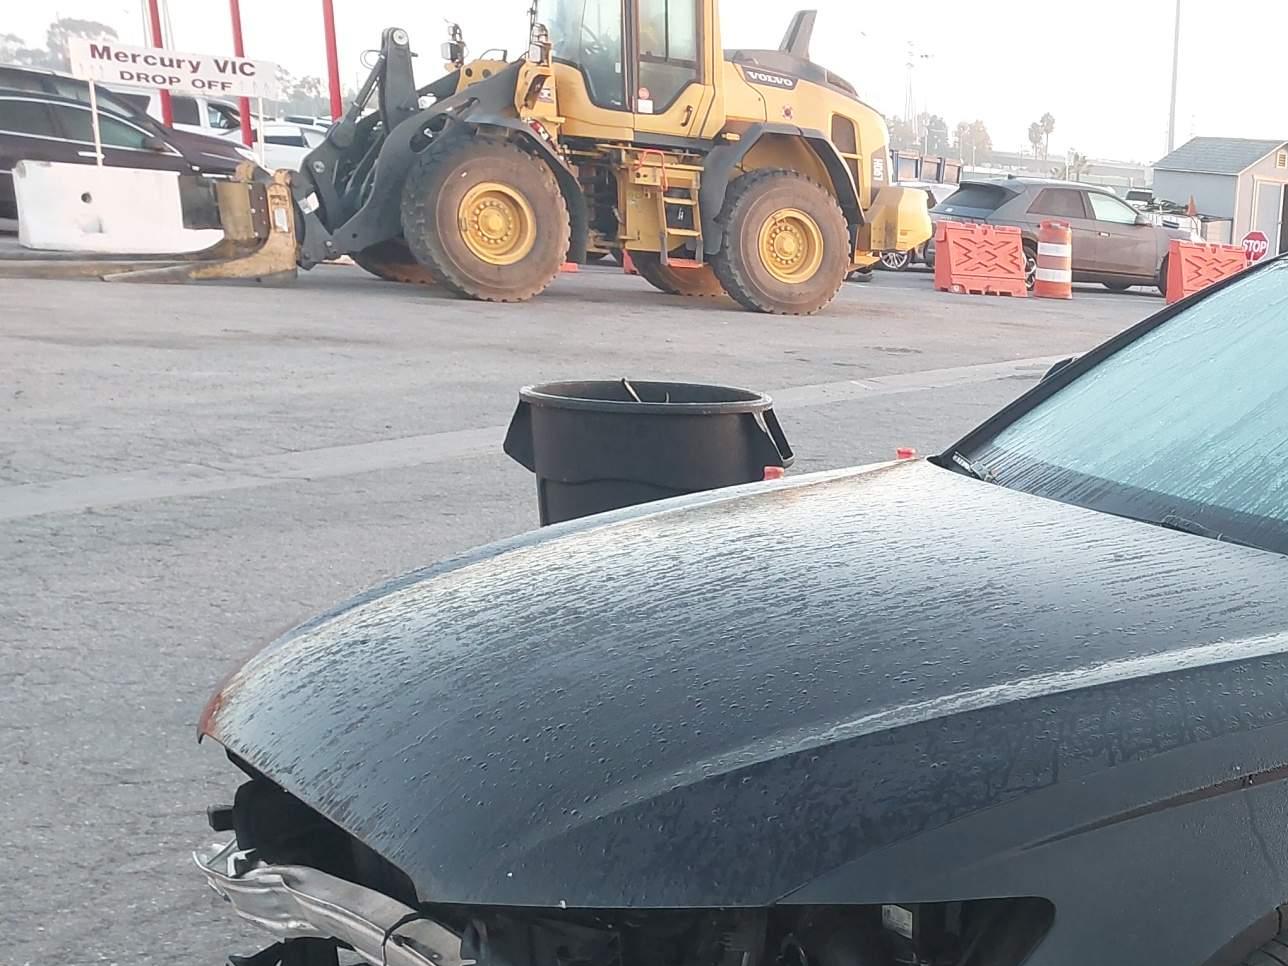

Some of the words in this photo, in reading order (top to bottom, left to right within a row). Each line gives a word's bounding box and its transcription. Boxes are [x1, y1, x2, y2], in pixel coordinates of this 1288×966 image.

[89, 44, 201, 74] Mercury
[213, 59, 256, 77] VIC
[119, 70, 181, 86] DROP
[191, 78, 233, 91] OFF
[746, 70, 793, 87] VOLVO
[1242, 239, 1267, 253] STOP
